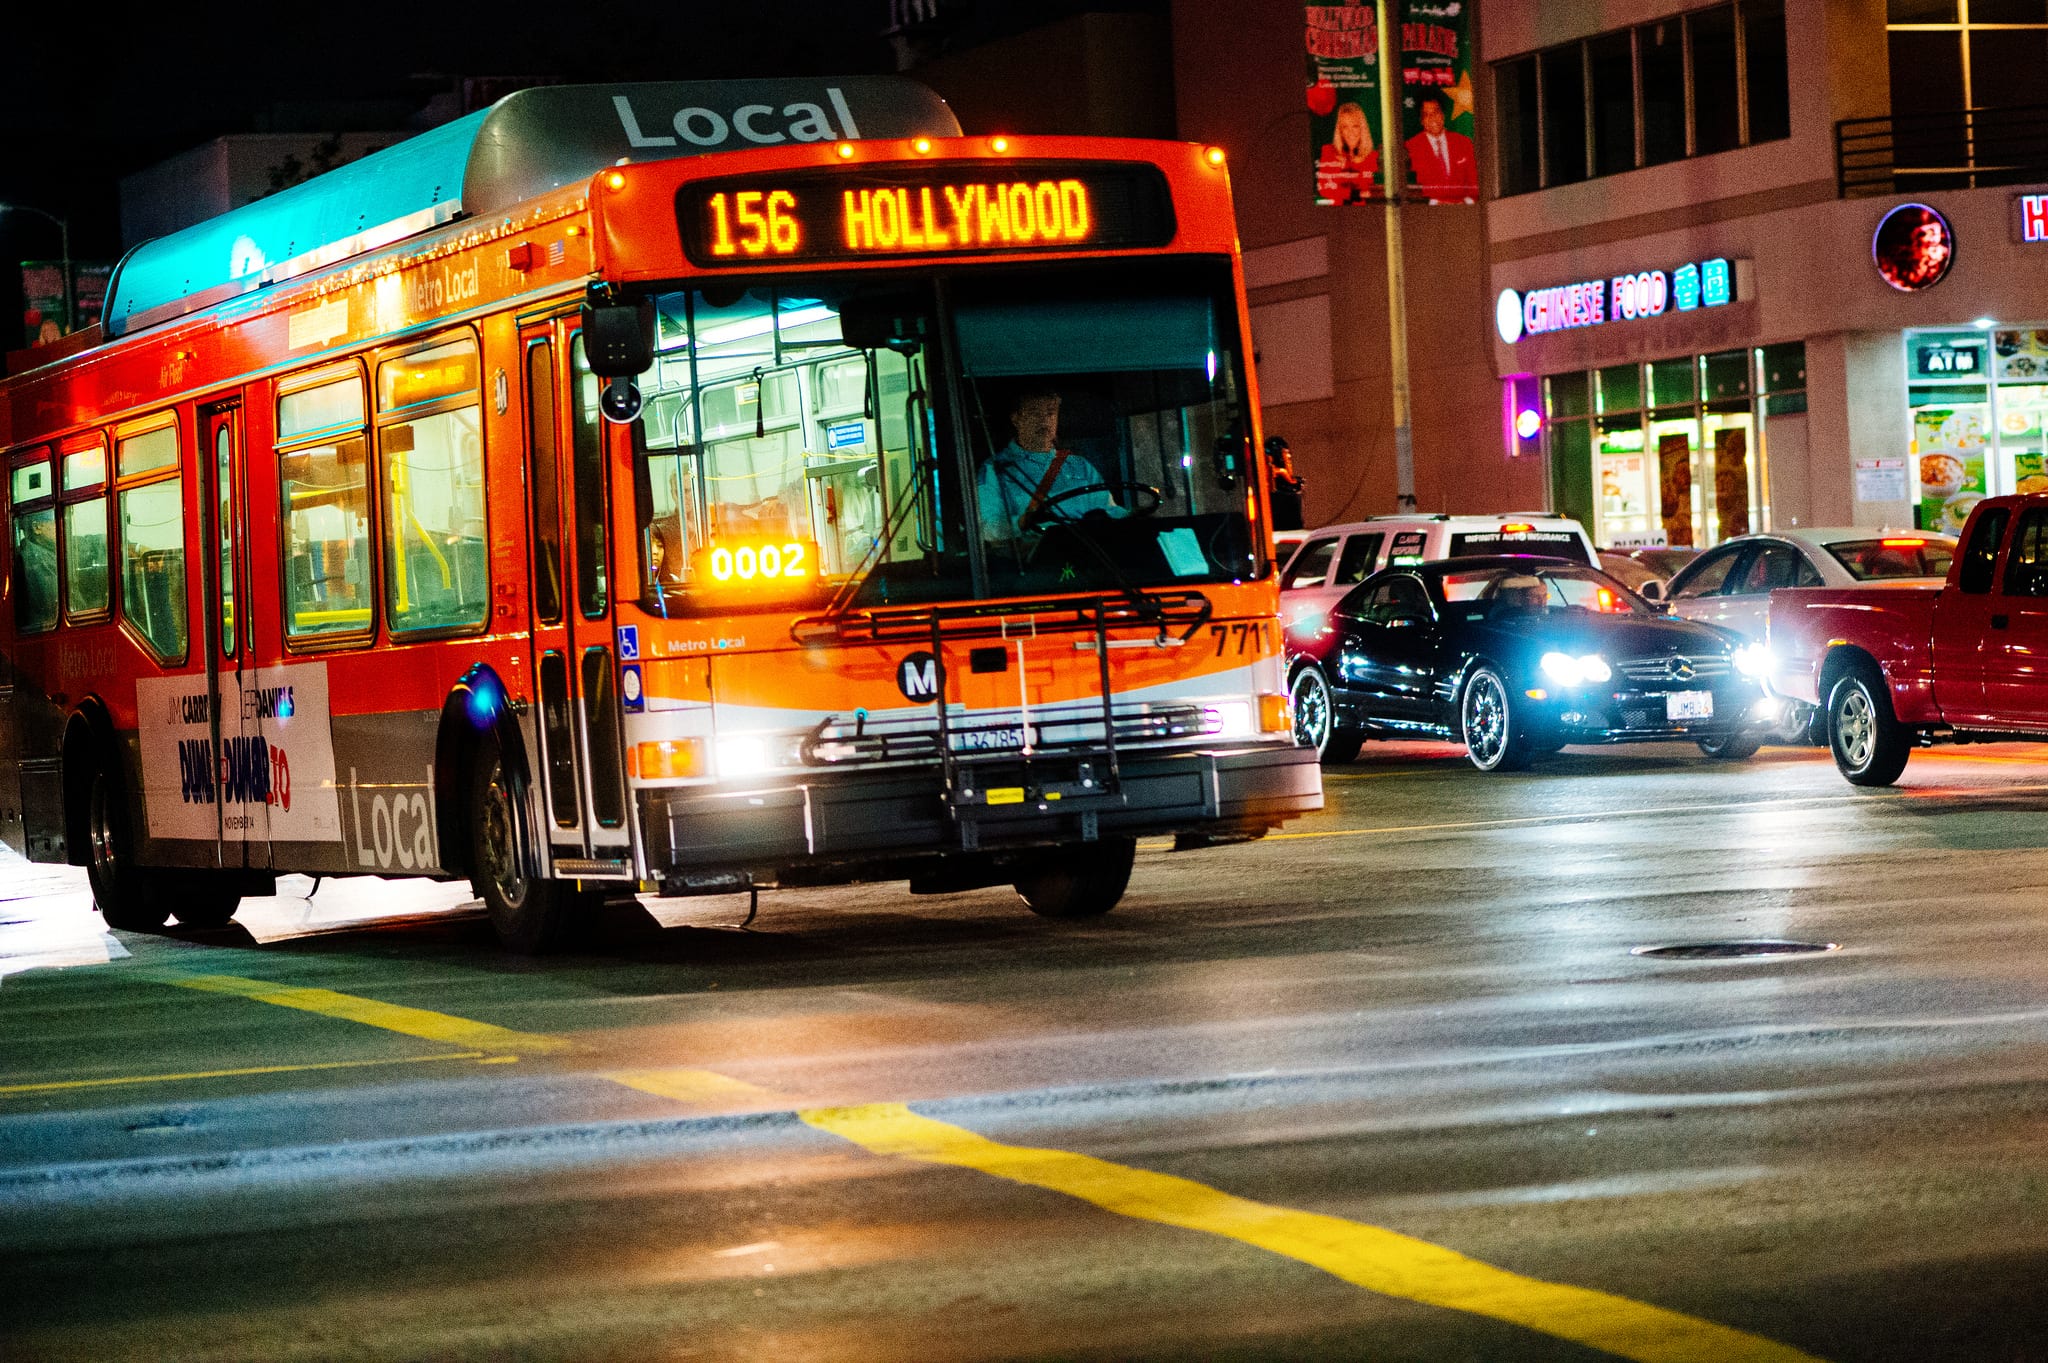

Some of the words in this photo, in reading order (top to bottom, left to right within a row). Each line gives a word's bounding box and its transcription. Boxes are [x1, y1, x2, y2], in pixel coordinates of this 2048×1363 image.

[612, 87, 860, 148] Local
[710, 190, 798, 255] 156
[843, 180, 1089, 248] HOLLYWOOD
[407, 274, 443, 313] Metro
[445, 256, 479, 303] Local
[1523, 280, 1605, 335] CHINESE
[1611, 270, 1667, 321] FOOD
[1928, 351, 1974, 371] ATM
[1465, 534, 1500, 543] INFINITY
[1502, 533, 1526, 542] AUTO
[1527, 534, 1571, 543] INSURANCE
[711, 543, 806, 581] 0002
[667, 640, 707, 652] Metro
[710, 635, 746, 650] Local
[1211, 621, 1270, 657] 7711
[350, 764, 440, 869] Local
